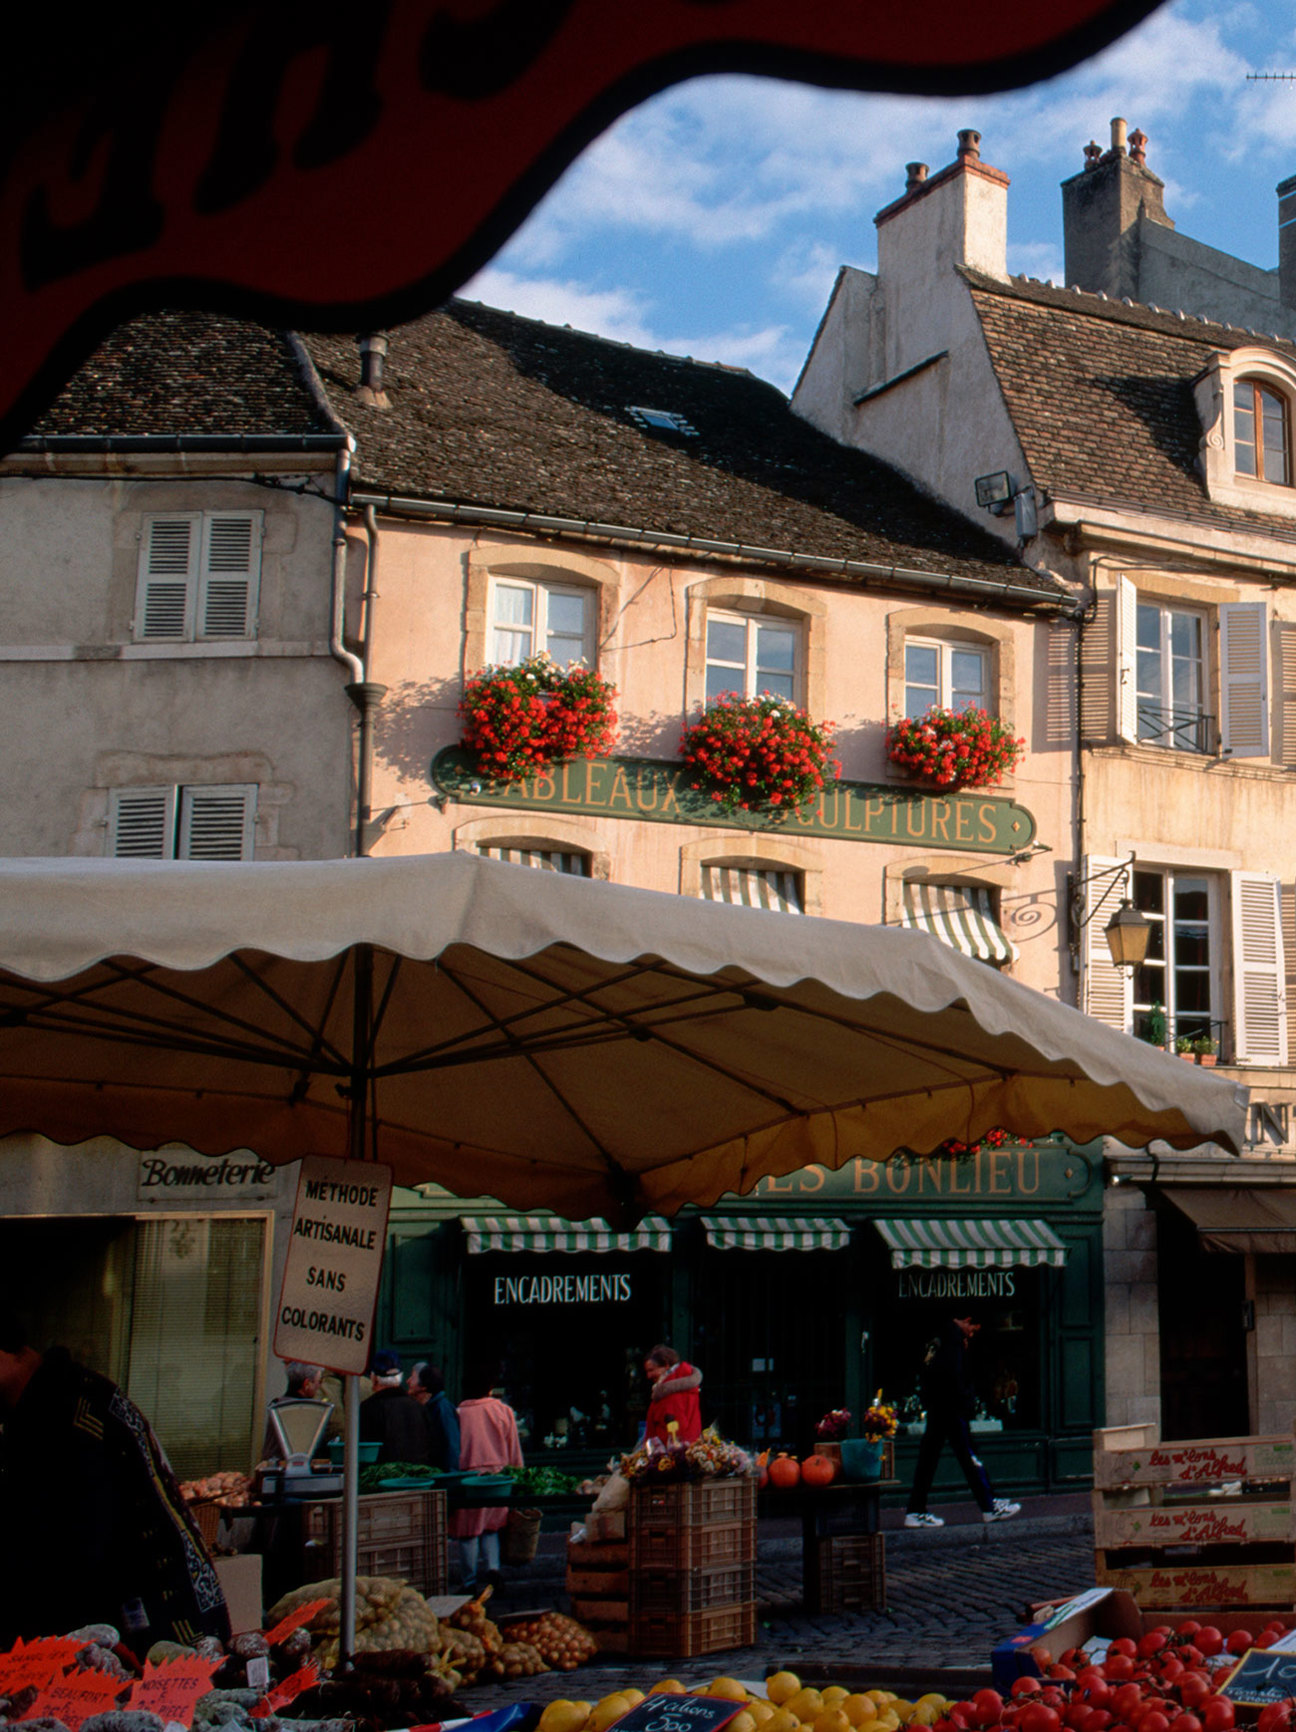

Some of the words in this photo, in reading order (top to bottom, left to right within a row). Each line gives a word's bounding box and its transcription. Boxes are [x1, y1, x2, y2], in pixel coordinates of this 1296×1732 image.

[141, 1158, 276, 1186] Bonneterie
[854, 1151, 1041, 1194] BONLIEU
[305, 1176, 379, 1207] MÉTHODE
[293, 1216, 377, 1251] ARTISANALE
[306, 1266, 347, 1293] SANS
[493, 1273, 633, 1305] ENCADREMENTS
[898, 1271, 1017, 1298] ENCADREMENTS
[281, 1306, 365, 1342] COLORANTS
